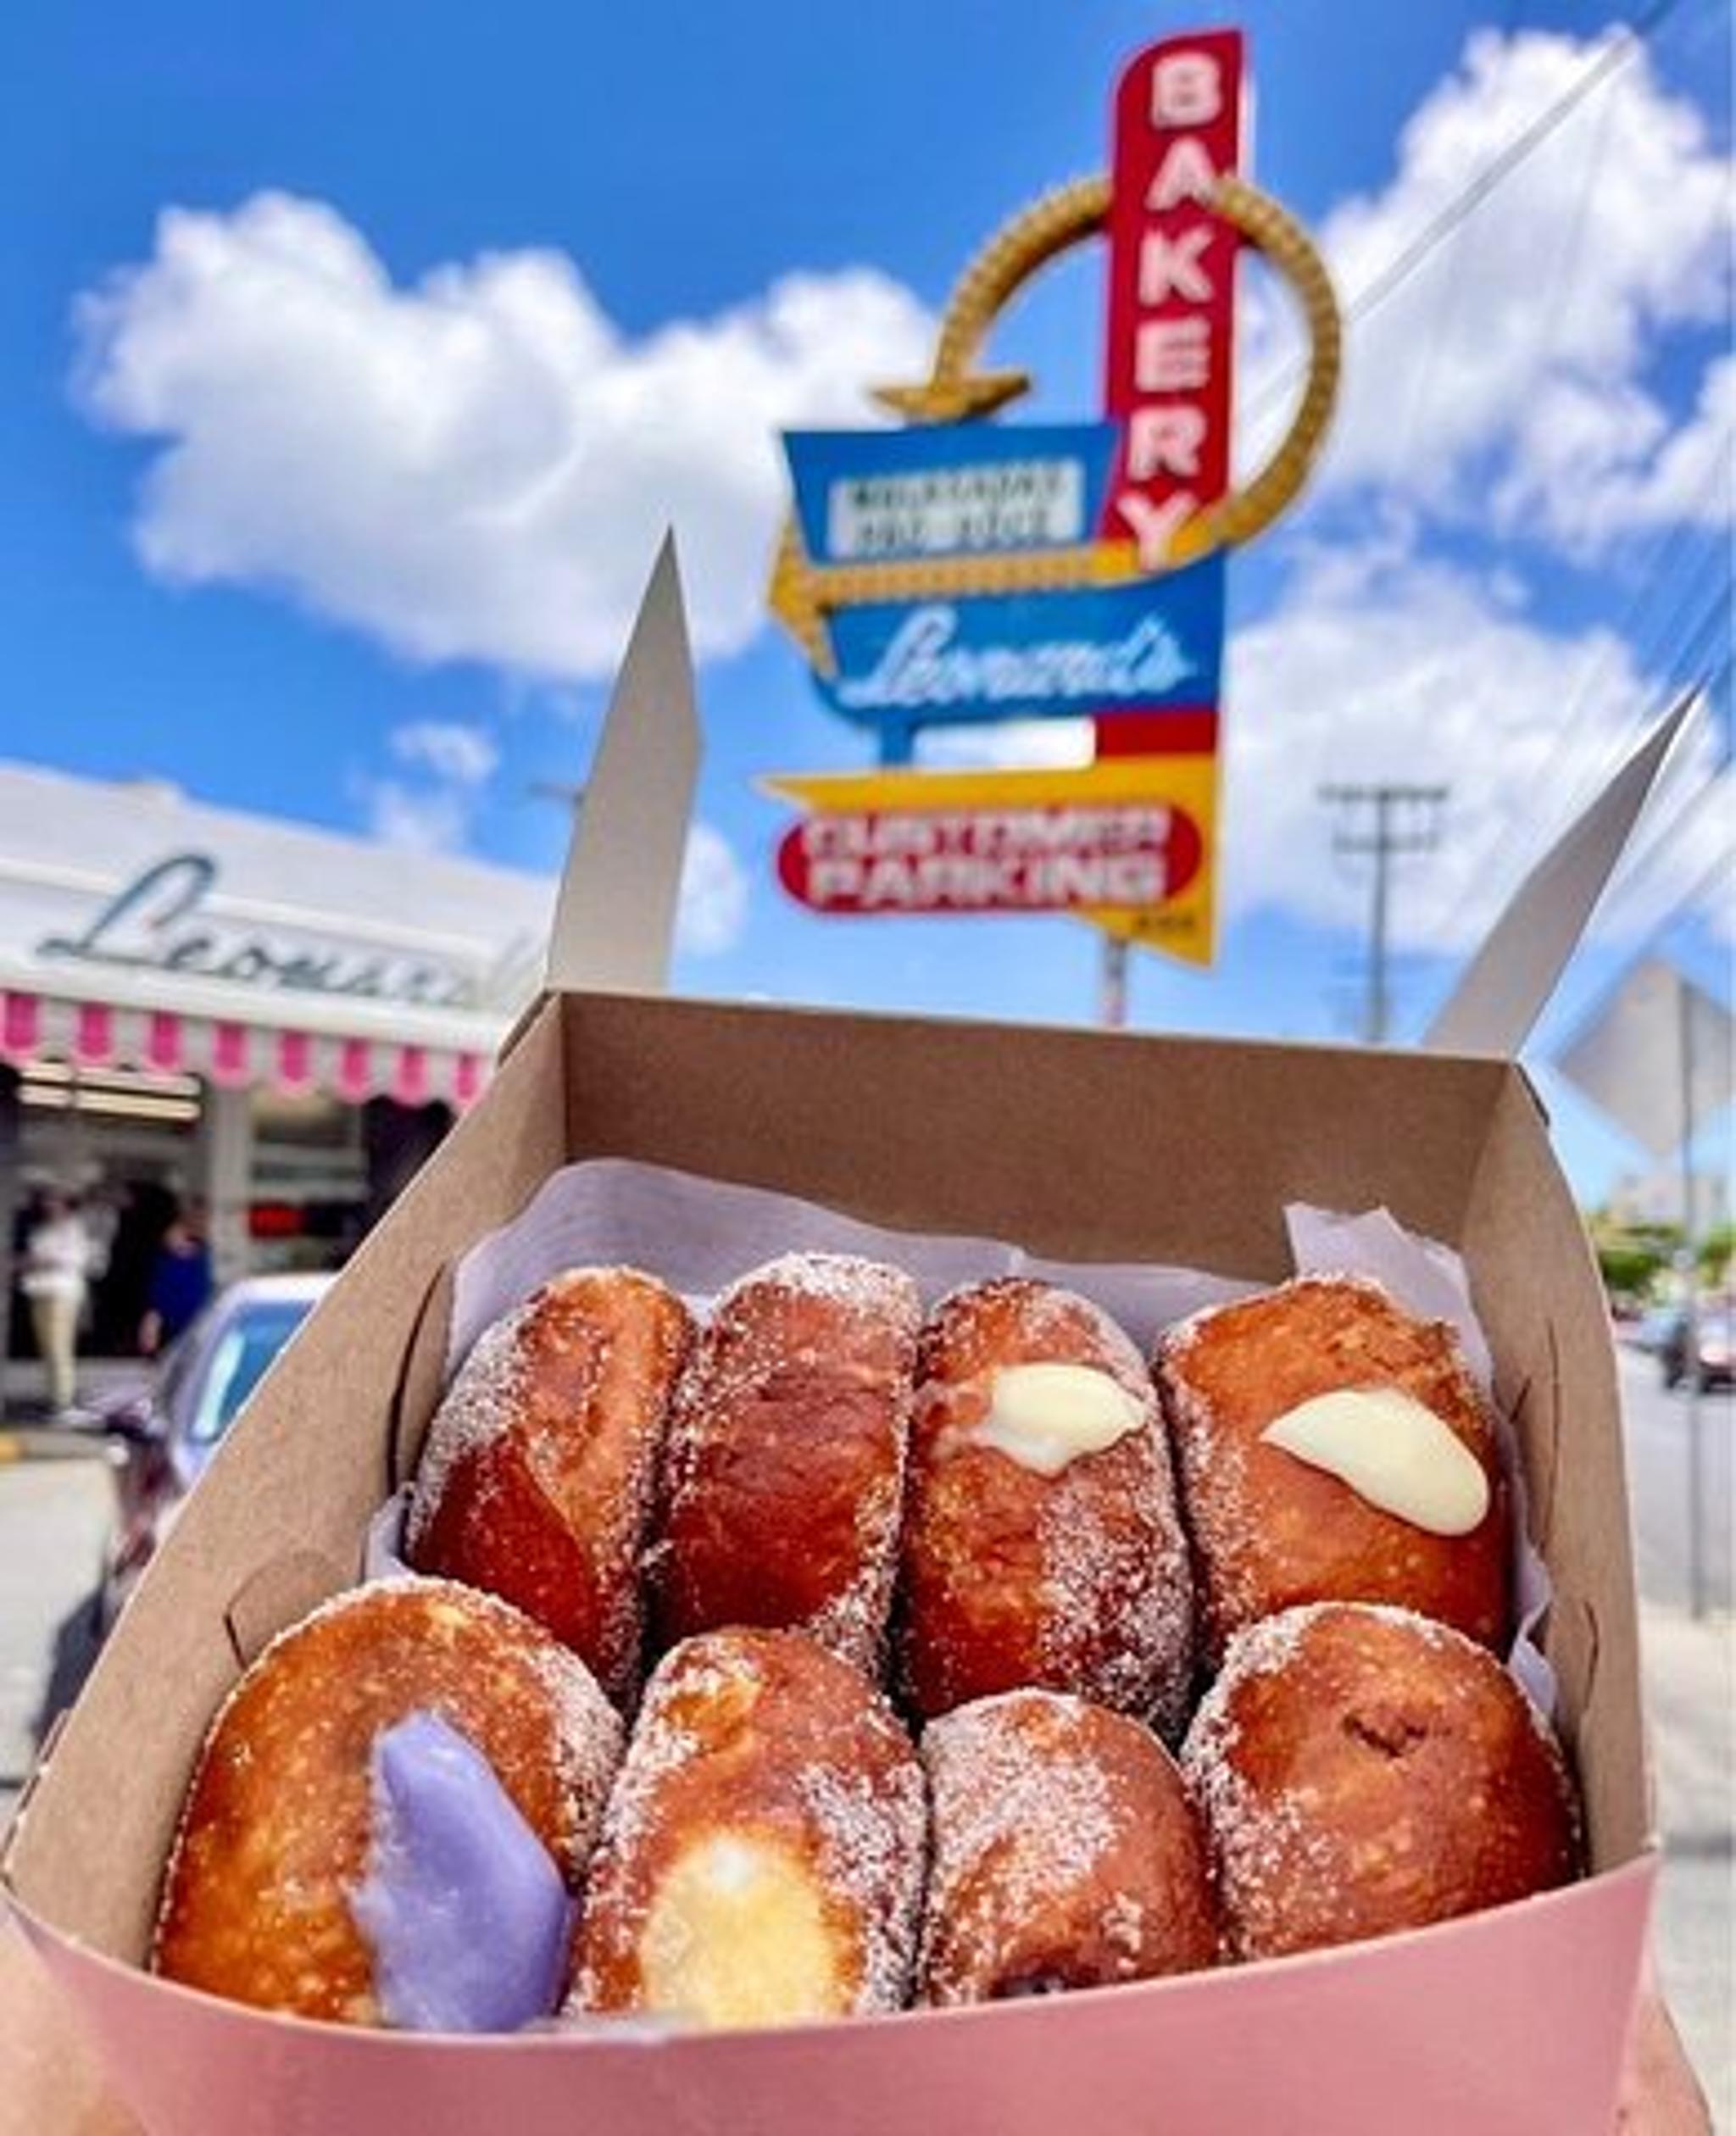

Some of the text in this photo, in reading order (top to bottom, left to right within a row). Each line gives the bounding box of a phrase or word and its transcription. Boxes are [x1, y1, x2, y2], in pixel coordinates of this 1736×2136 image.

[1117, 51, 1222, 570] BAKERY
[834, 605, 1199, 709] Leonard's
[807, 804, 1171, 858] CUSTOMER
[807, 850, 1168, 905] PARKING
